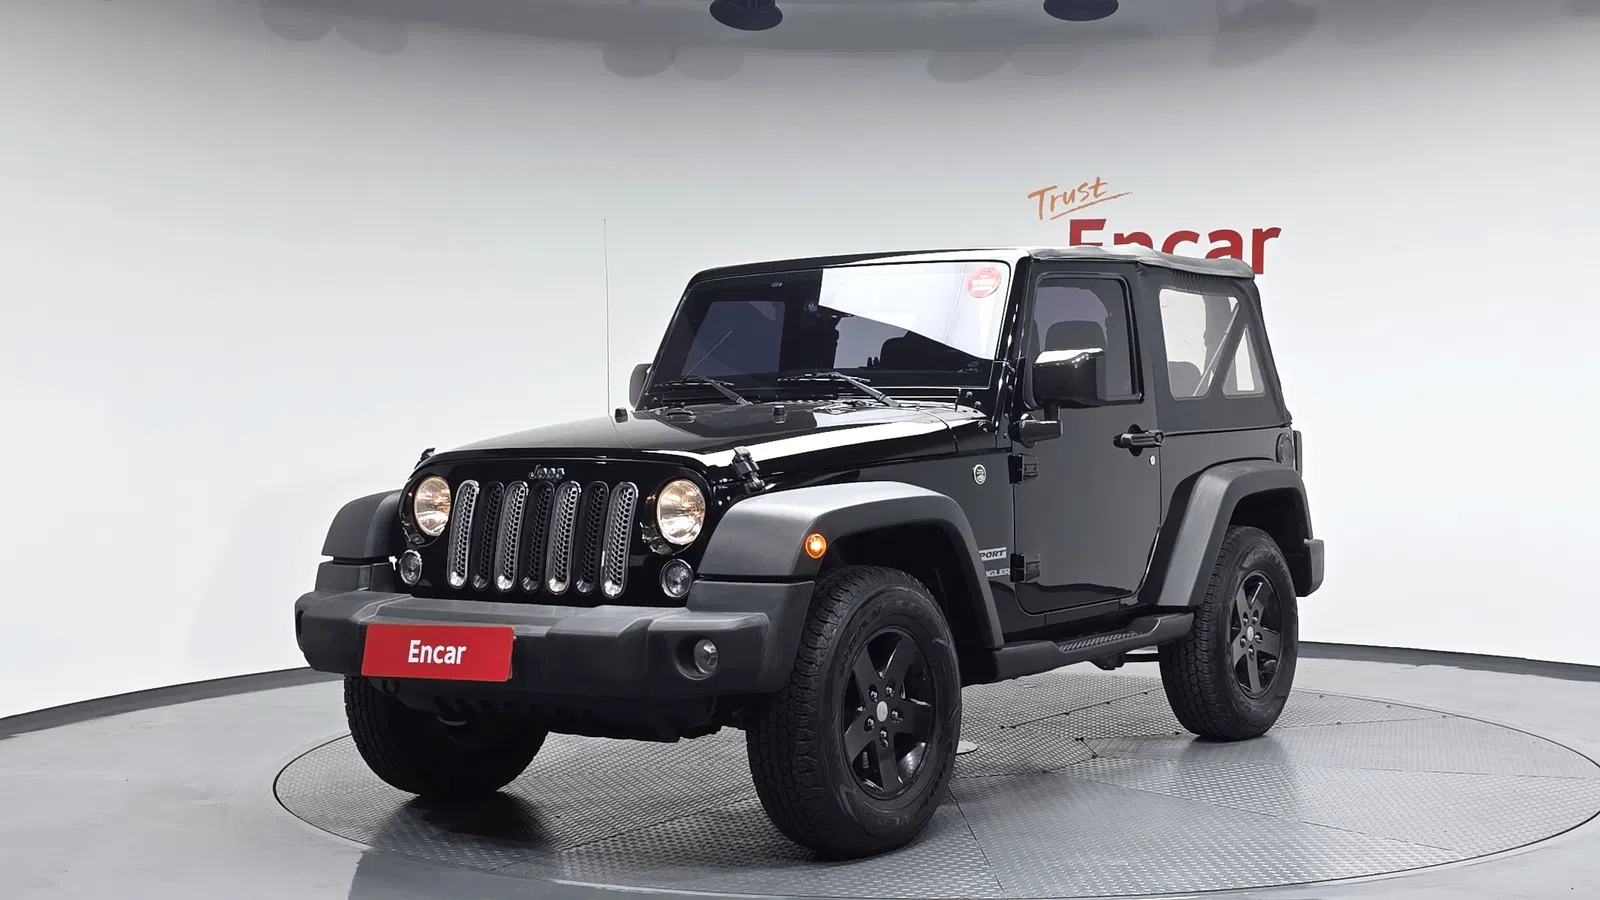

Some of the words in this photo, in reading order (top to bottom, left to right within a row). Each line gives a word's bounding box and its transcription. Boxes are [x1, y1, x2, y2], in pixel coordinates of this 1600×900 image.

[1027, 176, 1108, 220] Trust
[979, 549, 1005, 560] PORT
[986, 567, 1010, 578] GLER
[408, 639, 467, 665] Encar
